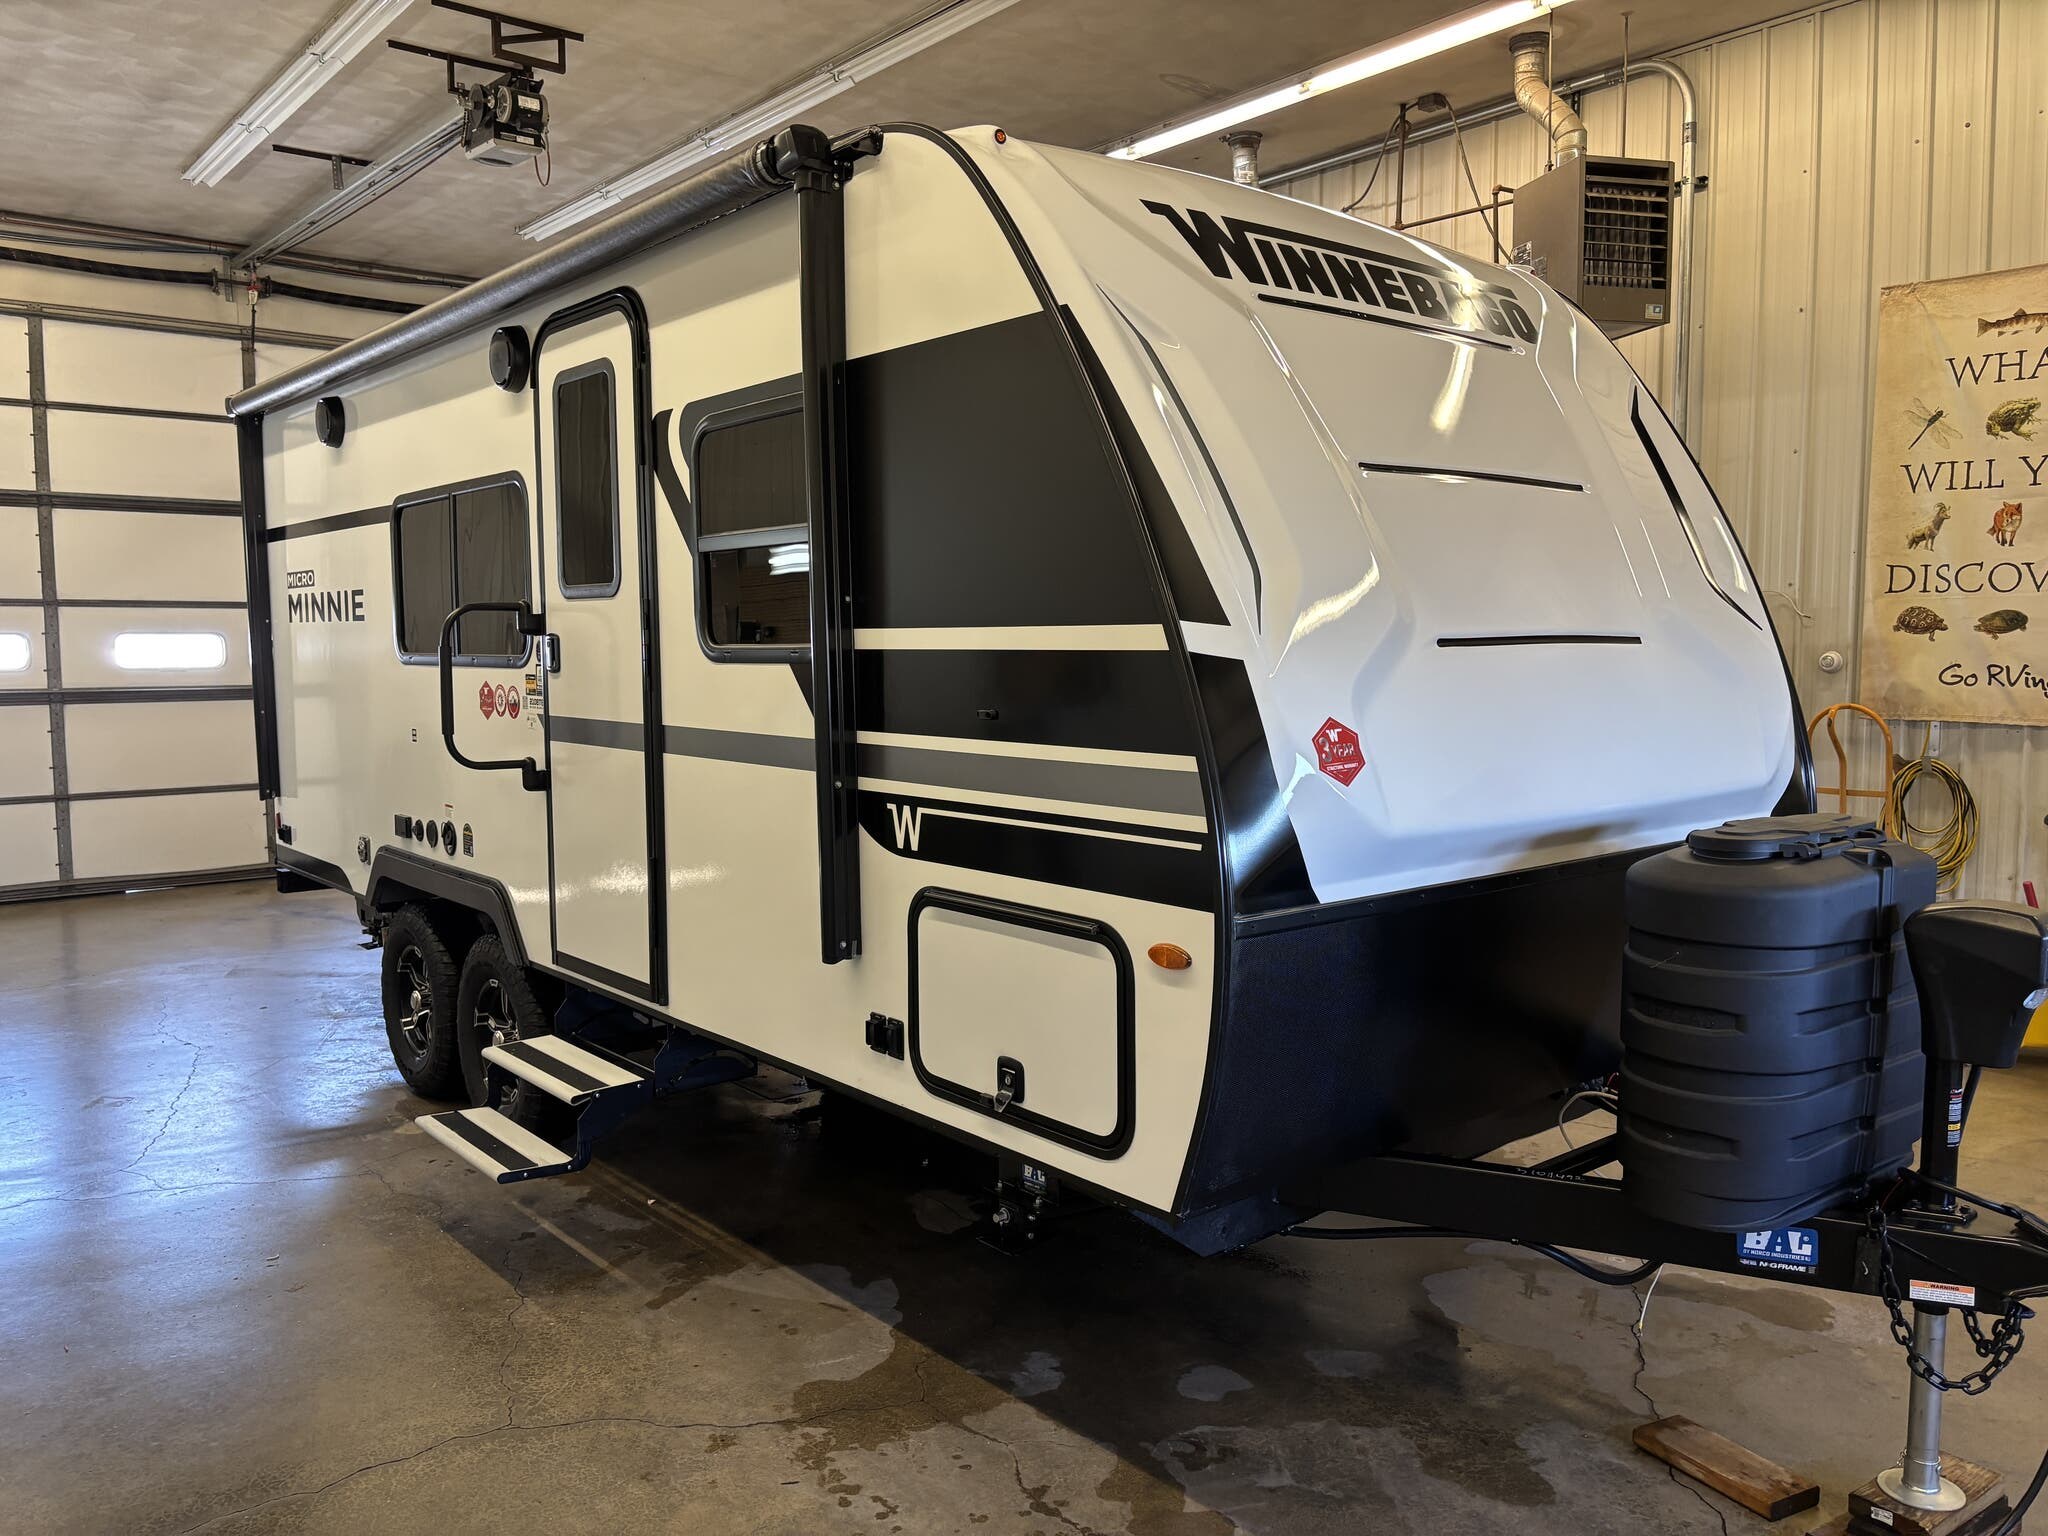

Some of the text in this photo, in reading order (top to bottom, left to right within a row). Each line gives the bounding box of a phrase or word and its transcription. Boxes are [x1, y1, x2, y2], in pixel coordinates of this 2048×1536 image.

[1900, 454, 2048, 494] WILL Y
[287, 572, 314, 587] MICRO
[1884, 561, 2048, 594] DISCOV
[288, 589, 365, 623] MINNIE
[1938, 663, 1978, 687] Go
[1319, 737, 1355, 762] 3 YEAR
[1930, 1283, 1959, 1291] WARNING
